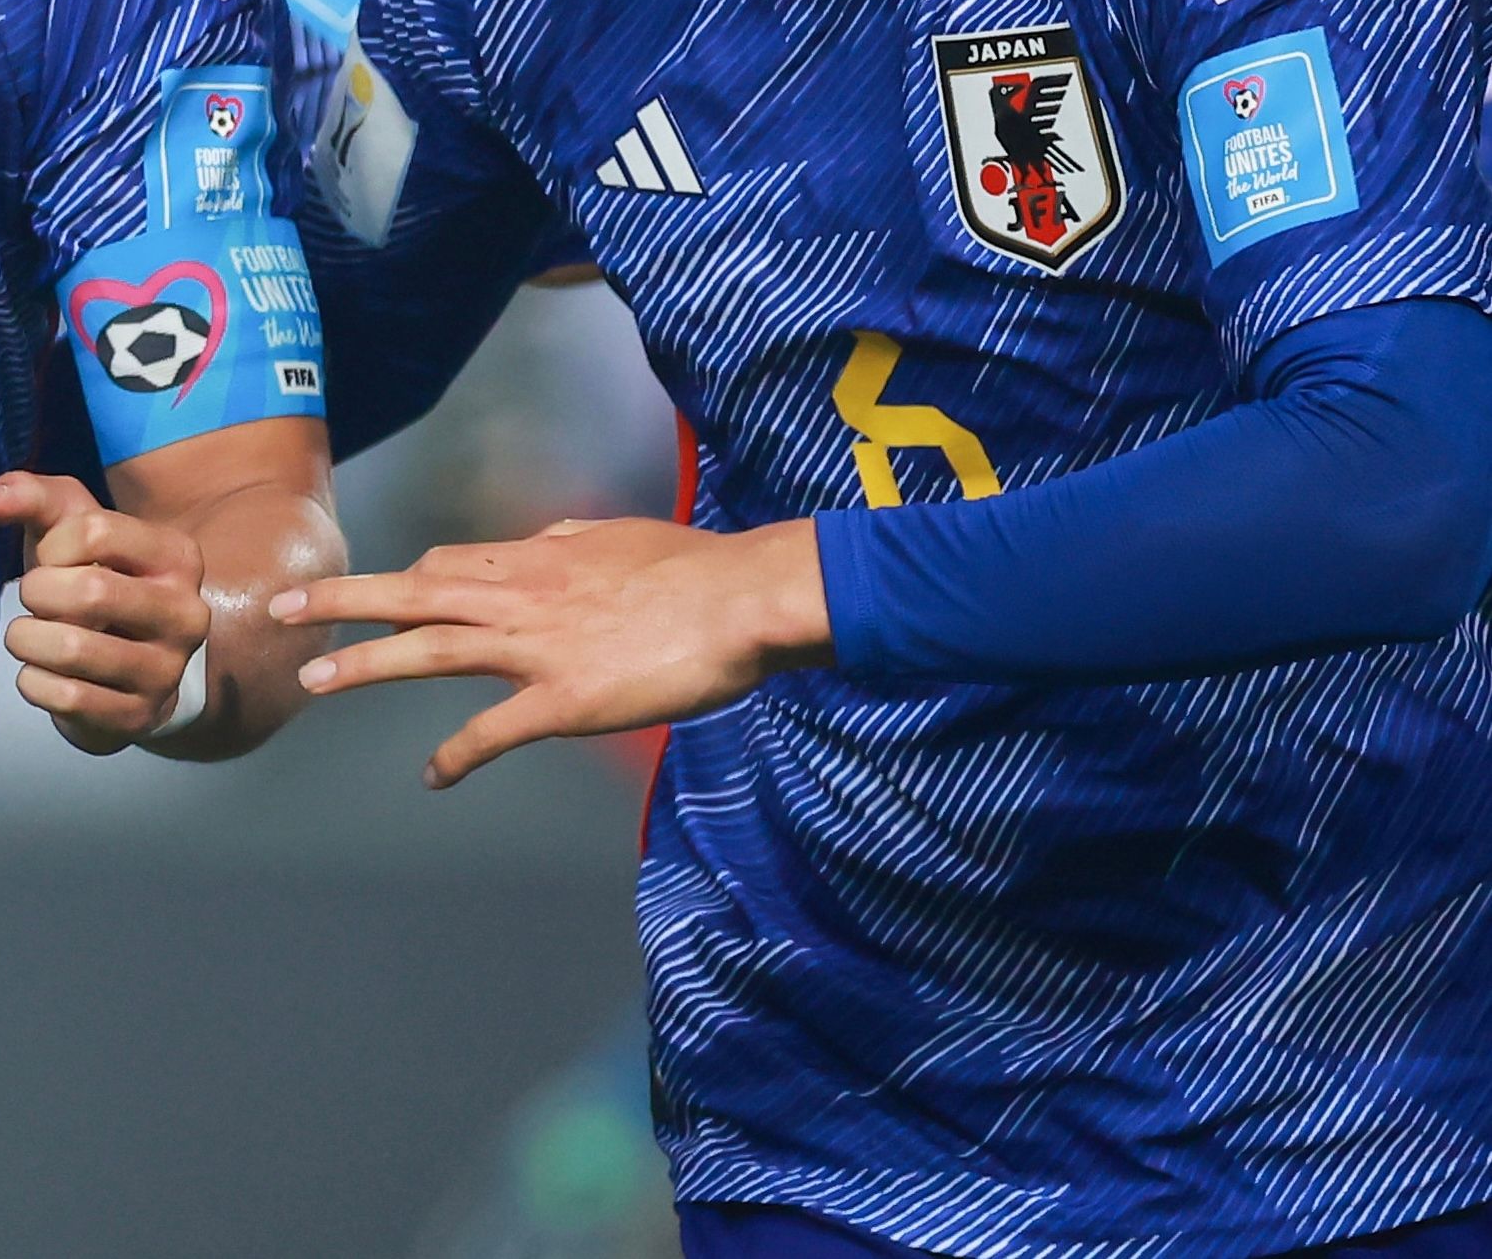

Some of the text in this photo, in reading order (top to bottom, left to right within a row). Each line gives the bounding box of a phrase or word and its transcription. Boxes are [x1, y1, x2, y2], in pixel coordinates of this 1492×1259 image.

[967, 36, 1047, 64] JAPAN
[1224, 122, 1290, 155] FOOTBALL
[1224, 141, 1293, 179] UNITES
[1225, 160, 1299, 201] the World
[1006, 190, 1082, 232] JFA
[1251, 193, 1280, 209] FIFA
[229, 244, 311, 276] FOOTBA
[240, 274, 319, 314] UNITE
[258, 315, 298, 349] the
[282, 368, 317, 389] FIFA
[831, 329, 1004, 511] 6
